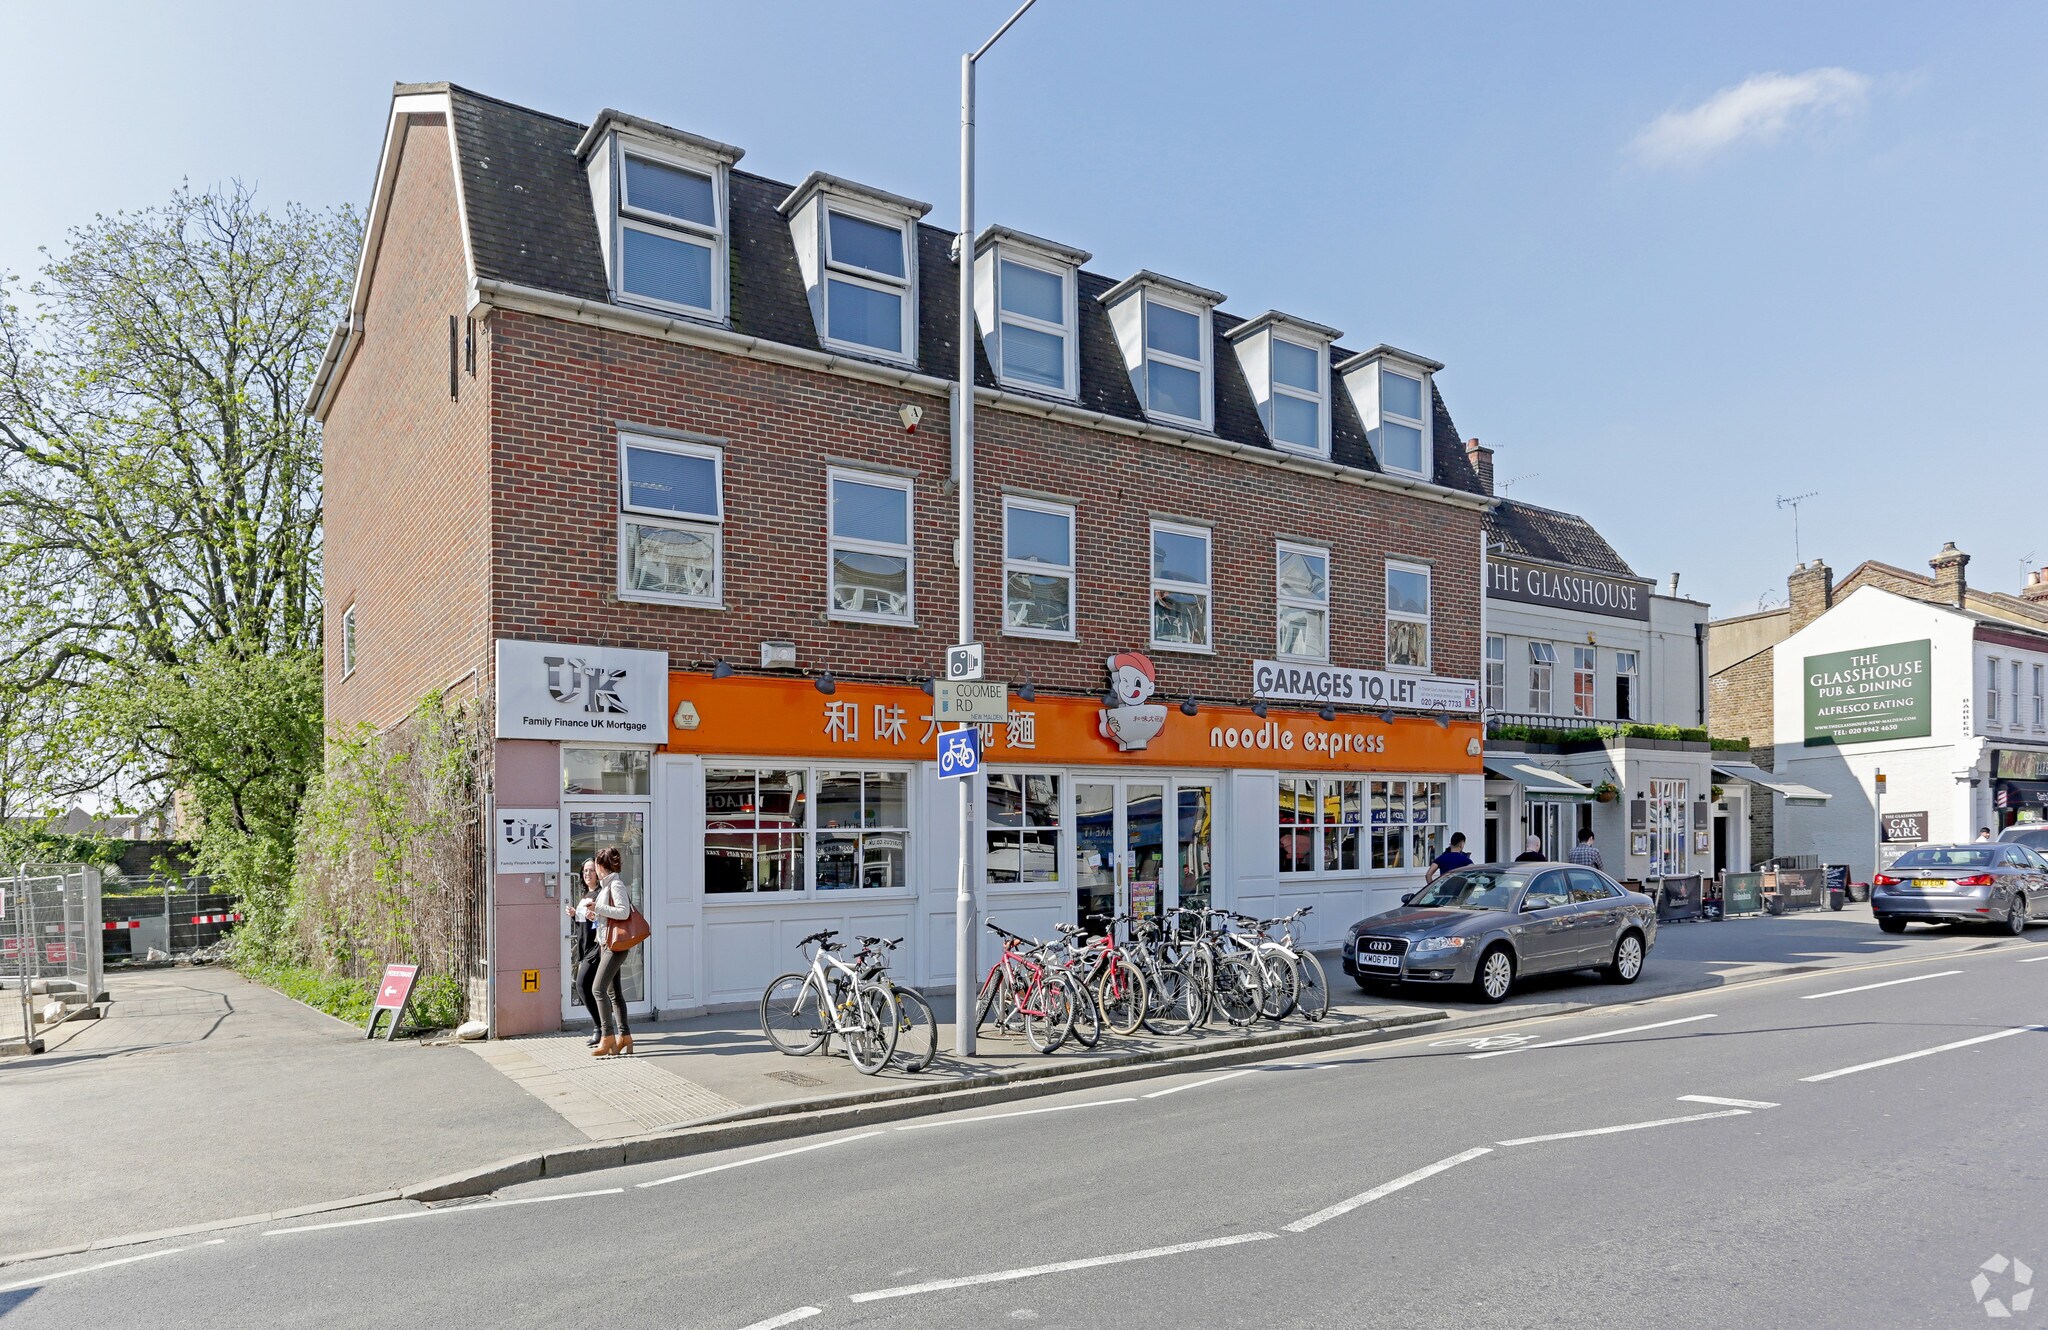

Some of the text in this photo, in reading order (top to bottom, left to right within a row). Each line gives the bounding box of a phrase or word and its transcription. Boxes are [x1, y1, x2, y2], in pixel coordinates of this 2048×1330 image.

[1486, 562, 1637, 611] THE GLASSHOUSE
[1850, 653, 1879, 667] THE
[1810, 660, 1922, 687] GLASSHOUSE
[543, 656, 629, 714] UK
[956, 684, 1002, 698] COOMBE
[1257, 666, 1417, 703] GARAGES TO LET
[1819, 677, 1912, 698] PUB & DINING
[956, 699, 973, 712] RD
[1818, 697, 1914, 716] ALFRESCO EATING
[523, 716, 647, 732] Family Finance UK Mortgage
[970, 713, 982, 721] NEW
[1848, 727, 1862, 735] 020
[1863, 726, 1879, 734] 8942
[1881, 724, 1898, 732] 4650
[1210, 721, 1385, 759] noodle express
[1890, 818, 1917, 828] CAR
[502, 818, 553, 850] UK
[1888, 827, 1921, 838] PARK
[524, 972, 538, 990] H
